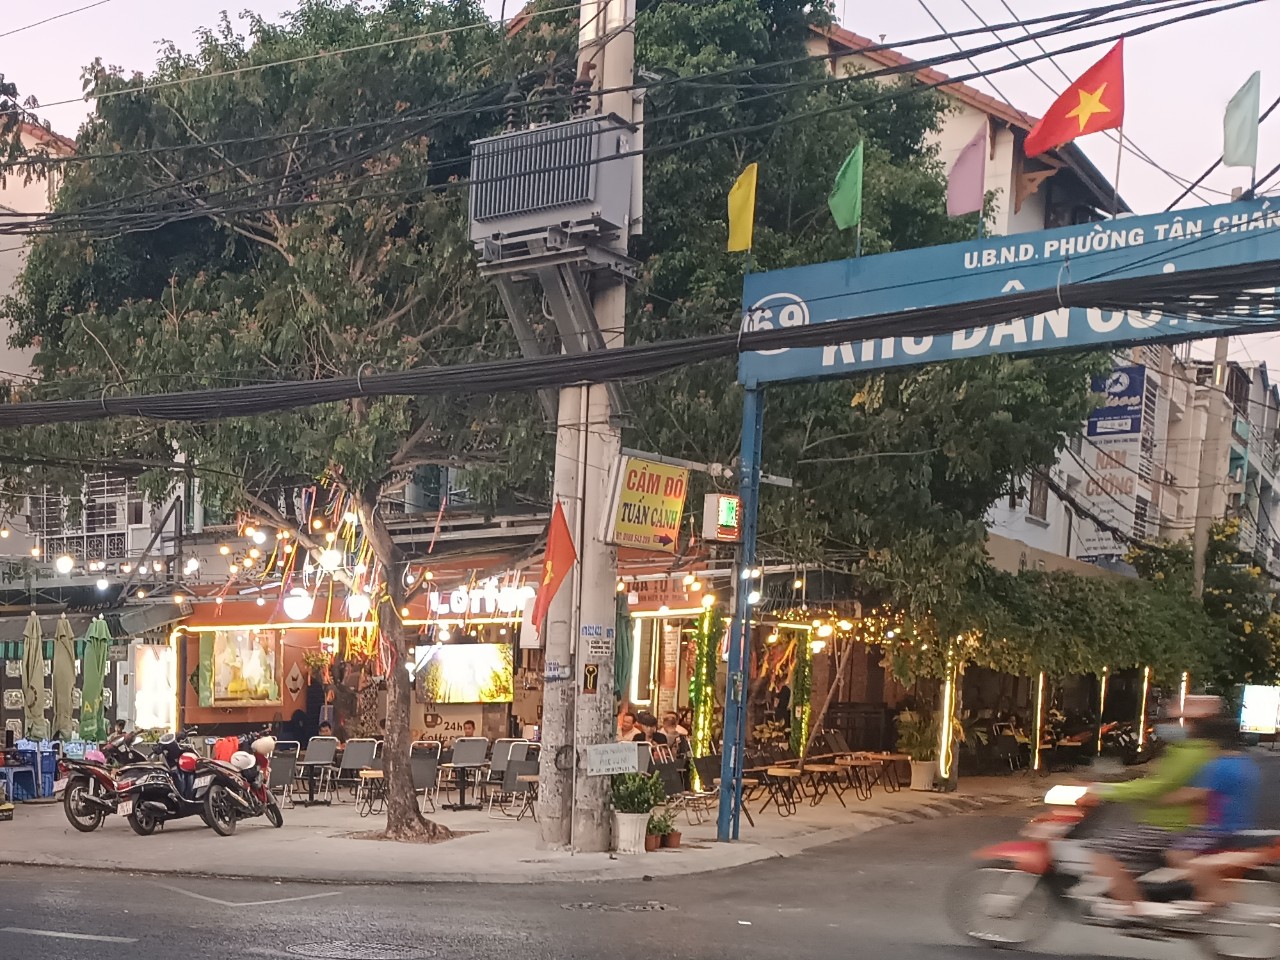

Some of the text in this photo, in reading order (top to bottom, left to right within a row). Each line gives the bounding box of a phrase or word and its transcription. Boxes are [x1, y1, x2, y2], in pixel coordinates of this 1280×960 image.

[964, 243, 1039, 269] U.B.N.D.
[1044, 223, 1145, 258] PHƯỜNG
[1154, 216, 1203, 242] TÂN
[1096, 450, 1127, 471] NAM
[626, 464, 684, 499] CẦM ĐỒ
[1085, 472, 1134, 497] CƯỜNG
[621, 495, 678, 530] TUẤN CẢNH
[443, 721, 463, 731] 24h
